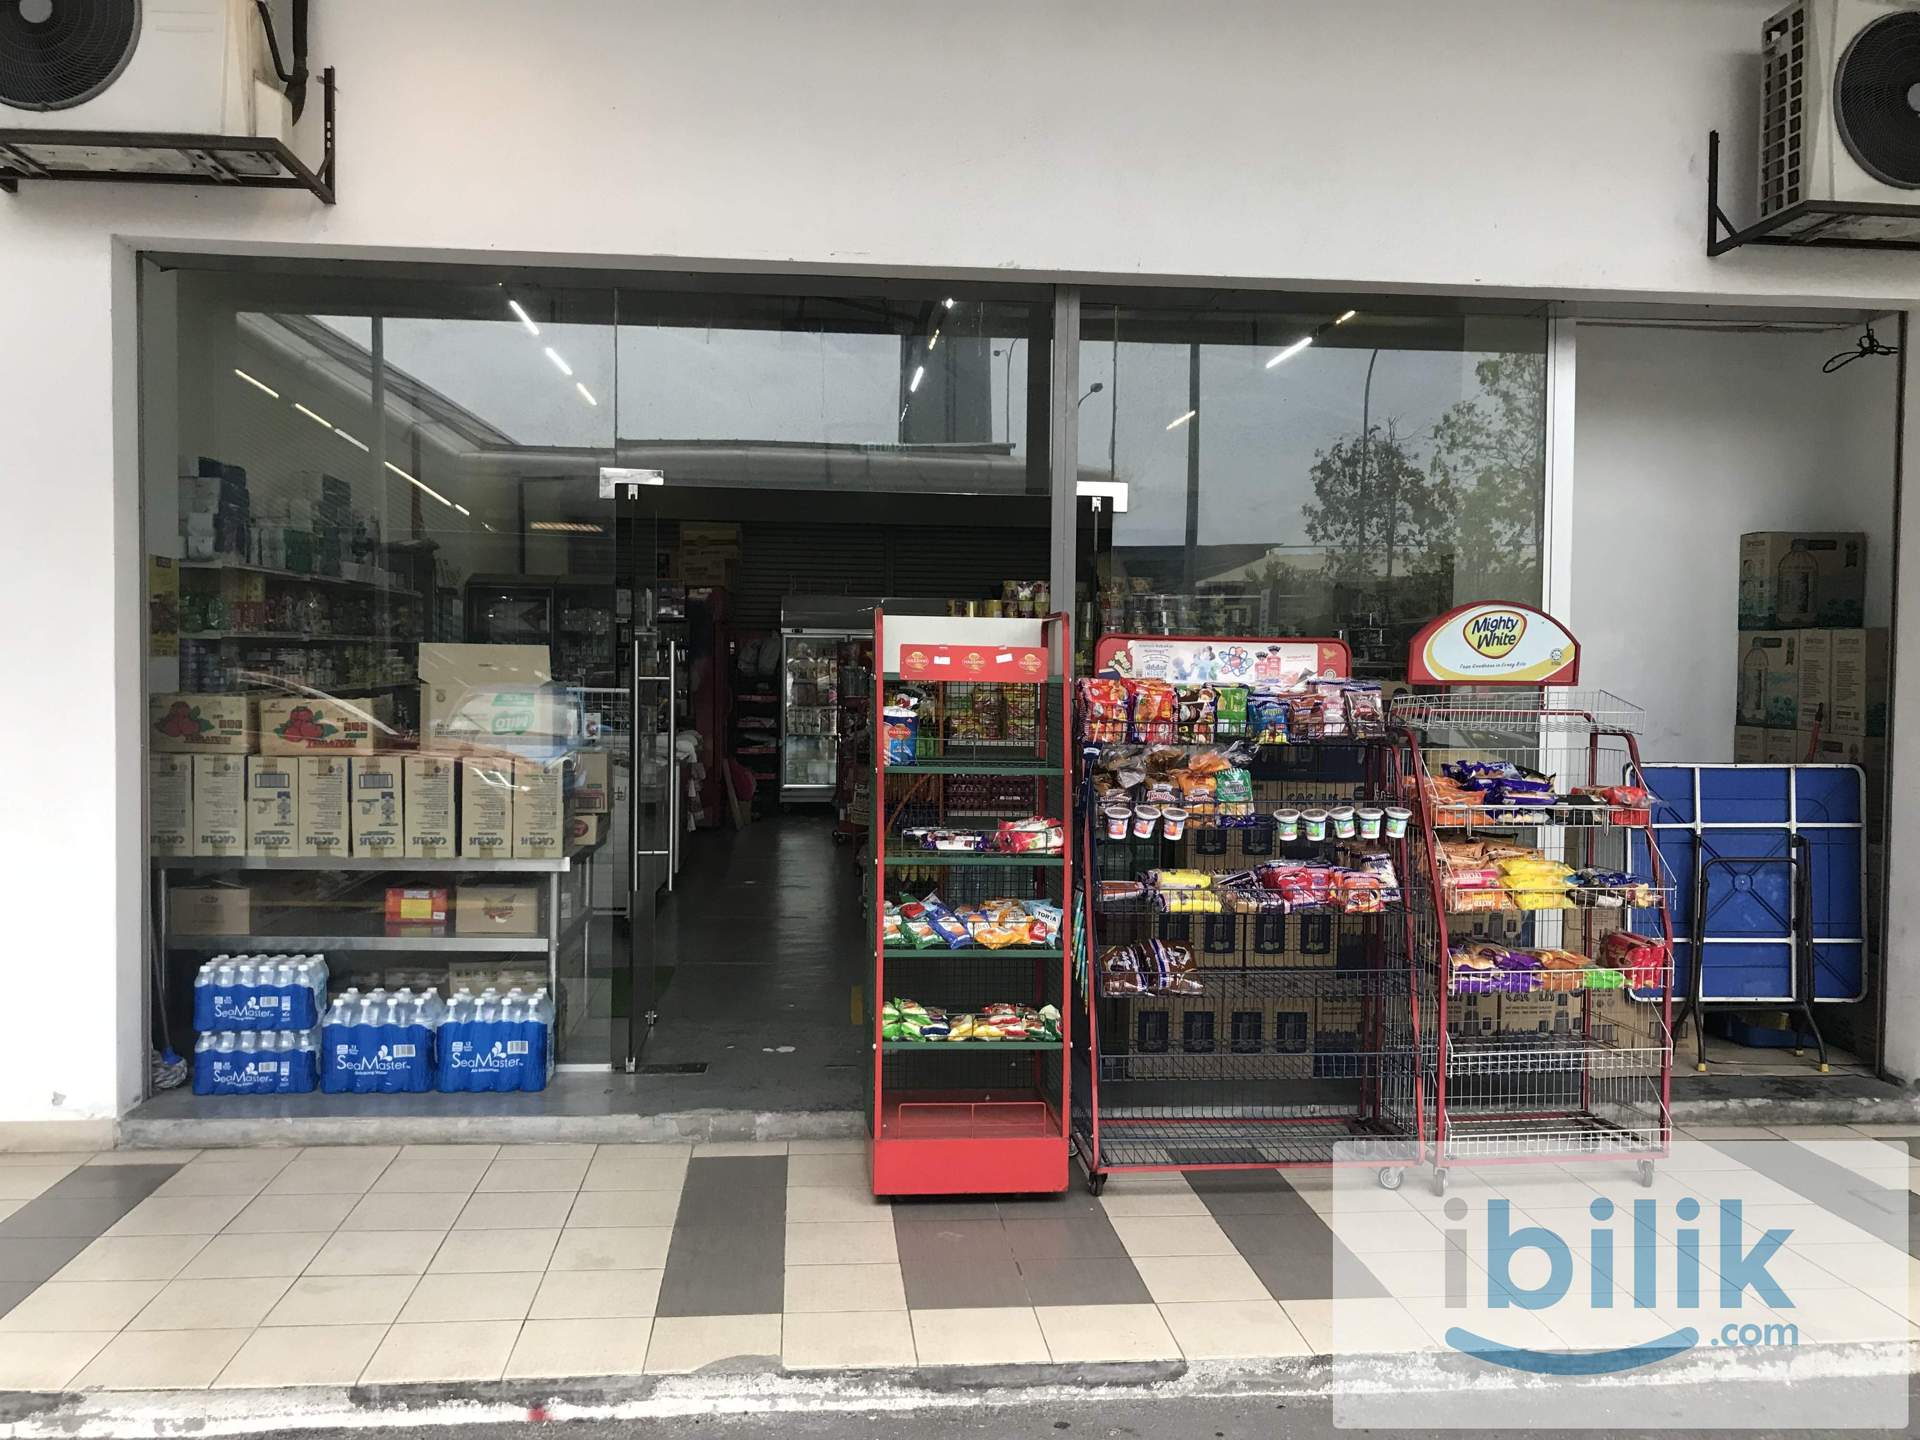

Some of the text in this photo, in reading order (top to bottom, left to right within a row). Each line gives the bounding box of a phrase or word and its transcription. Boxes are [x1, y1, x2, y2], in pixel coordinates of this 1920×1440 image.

[1471, 616, 1519, 635] Mighty
[1477, 631, 1517, 650] White
[214, 1004, 271, 1018] SeaMaster
[336, 1054, 407, 1071] SeaMaster
[451, 1051, 520, 1069] SeaMaster
[213, 1070, 269, 1083] SeaMaster
